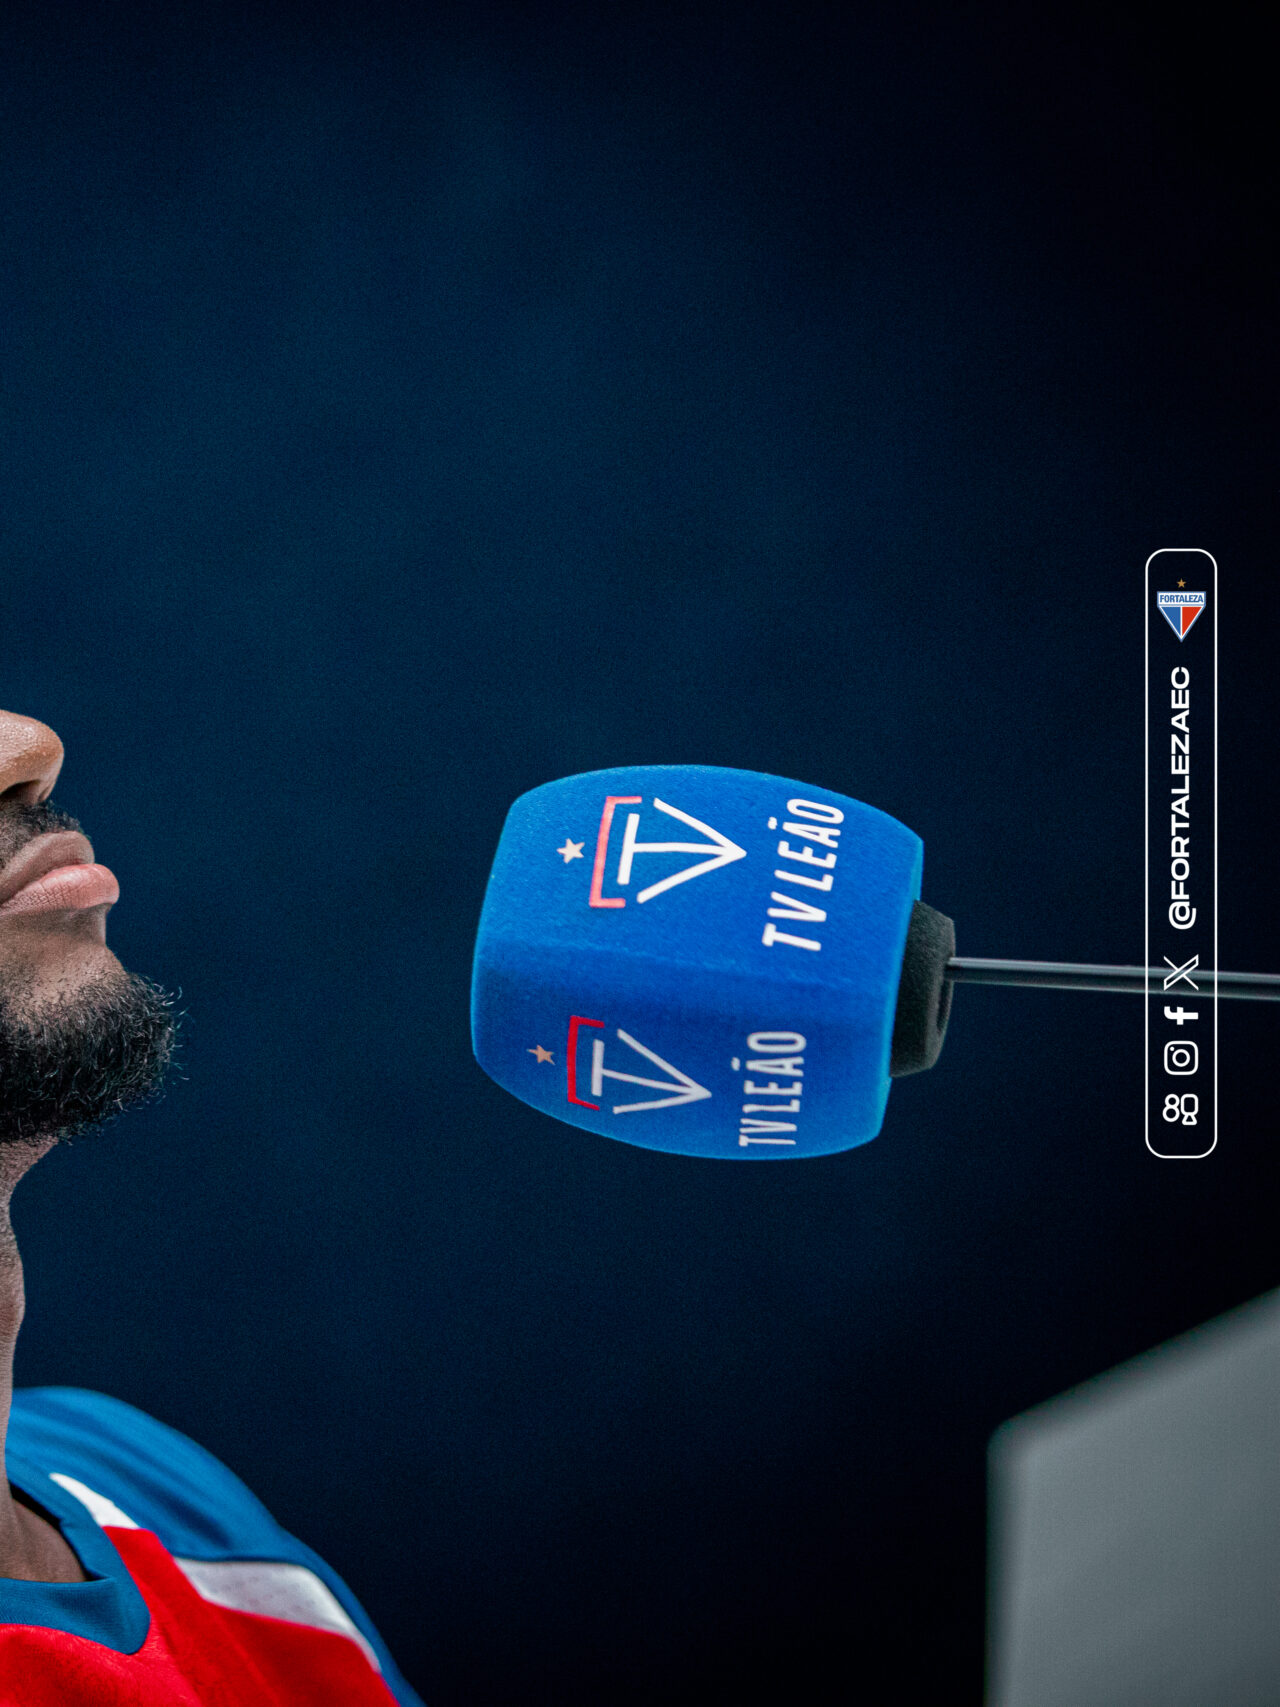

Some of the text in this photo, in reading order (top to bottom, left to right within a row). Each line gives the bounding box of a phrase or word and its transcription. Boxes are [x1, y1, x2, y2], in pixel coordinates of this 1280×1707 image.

[761, 798, 845, 952] TV LEÃO
[731, 1031, 807, 1147] TV LEÃO
